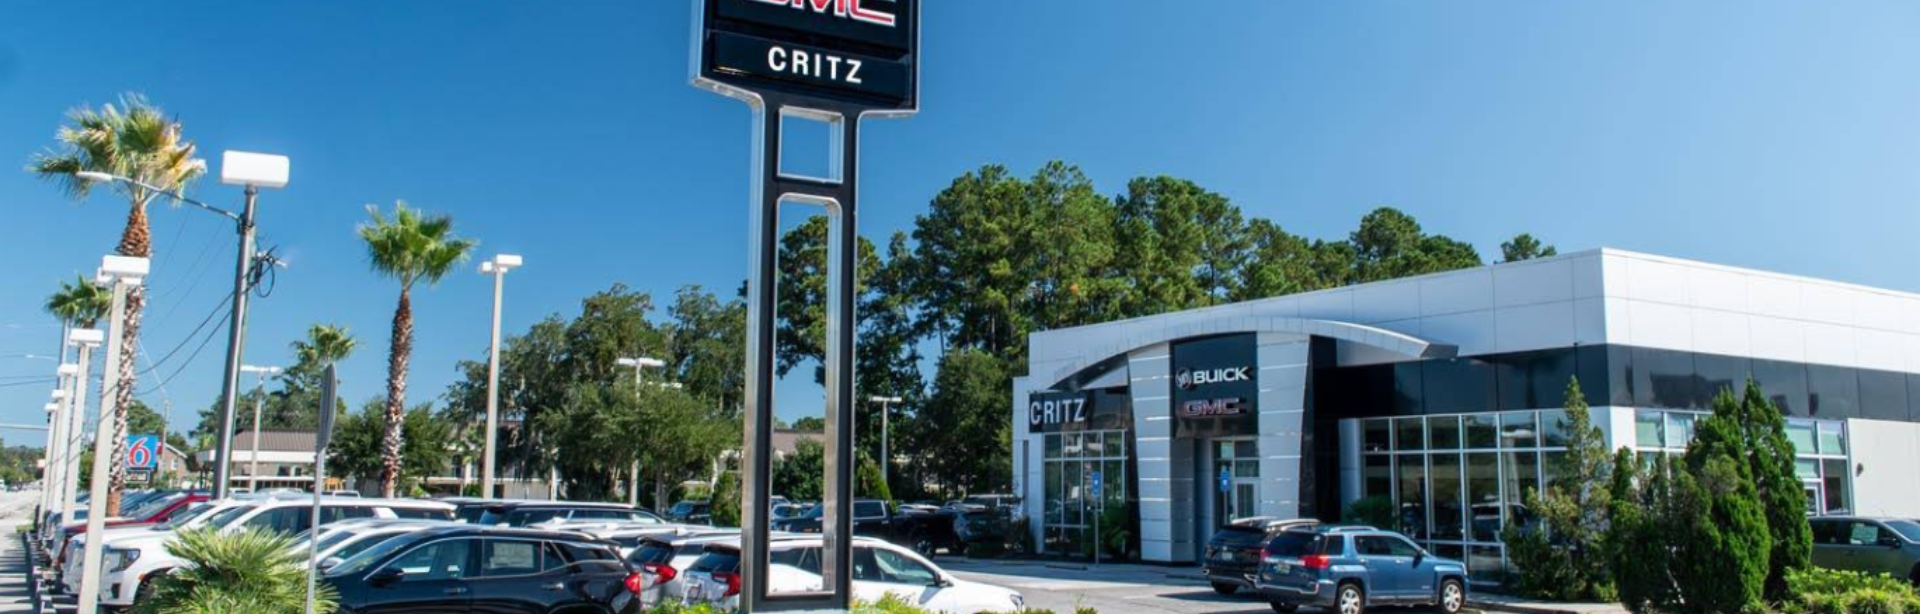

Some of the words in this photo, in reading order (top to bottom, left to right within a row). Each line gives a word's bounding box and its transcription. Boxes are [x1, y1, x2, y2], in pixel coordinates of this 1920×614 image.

[767, 45, 863, 84] CRITZ
[1193, 366, 1249, 384] BUICK
[1030, 398, 1085, 425] CRITZ
[1183, 397, 1240, 416] GMC
[128, 437, 150, 467] 6
